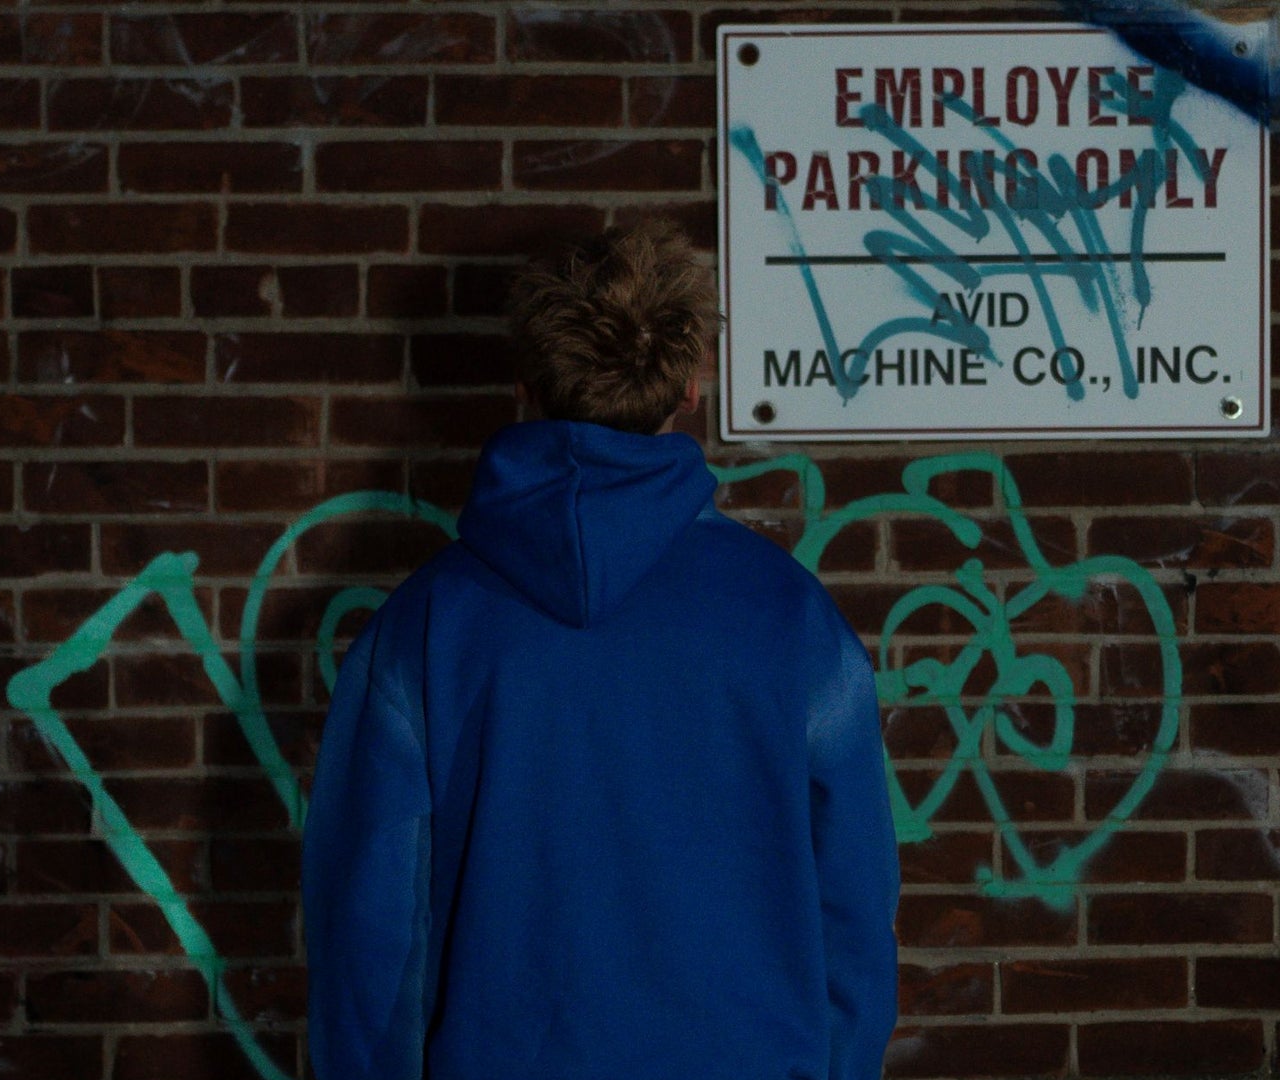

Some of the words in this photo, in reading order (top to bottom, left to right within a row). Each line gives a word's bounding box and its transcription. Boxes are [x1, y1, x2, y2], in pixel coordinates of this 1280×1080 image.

[835, 66, 1157, 128] EMPLOYEE
[764, 148, 1039, 211] PARKING
[1075, 147, 1228, 210] ONLY
[930, 292, 1029, 329] AVID
[763, 348, 987, 387] MACHINE
[1012, 346, 1111, 393] CO.,
[1136, 345, 1232, 385] INC.
